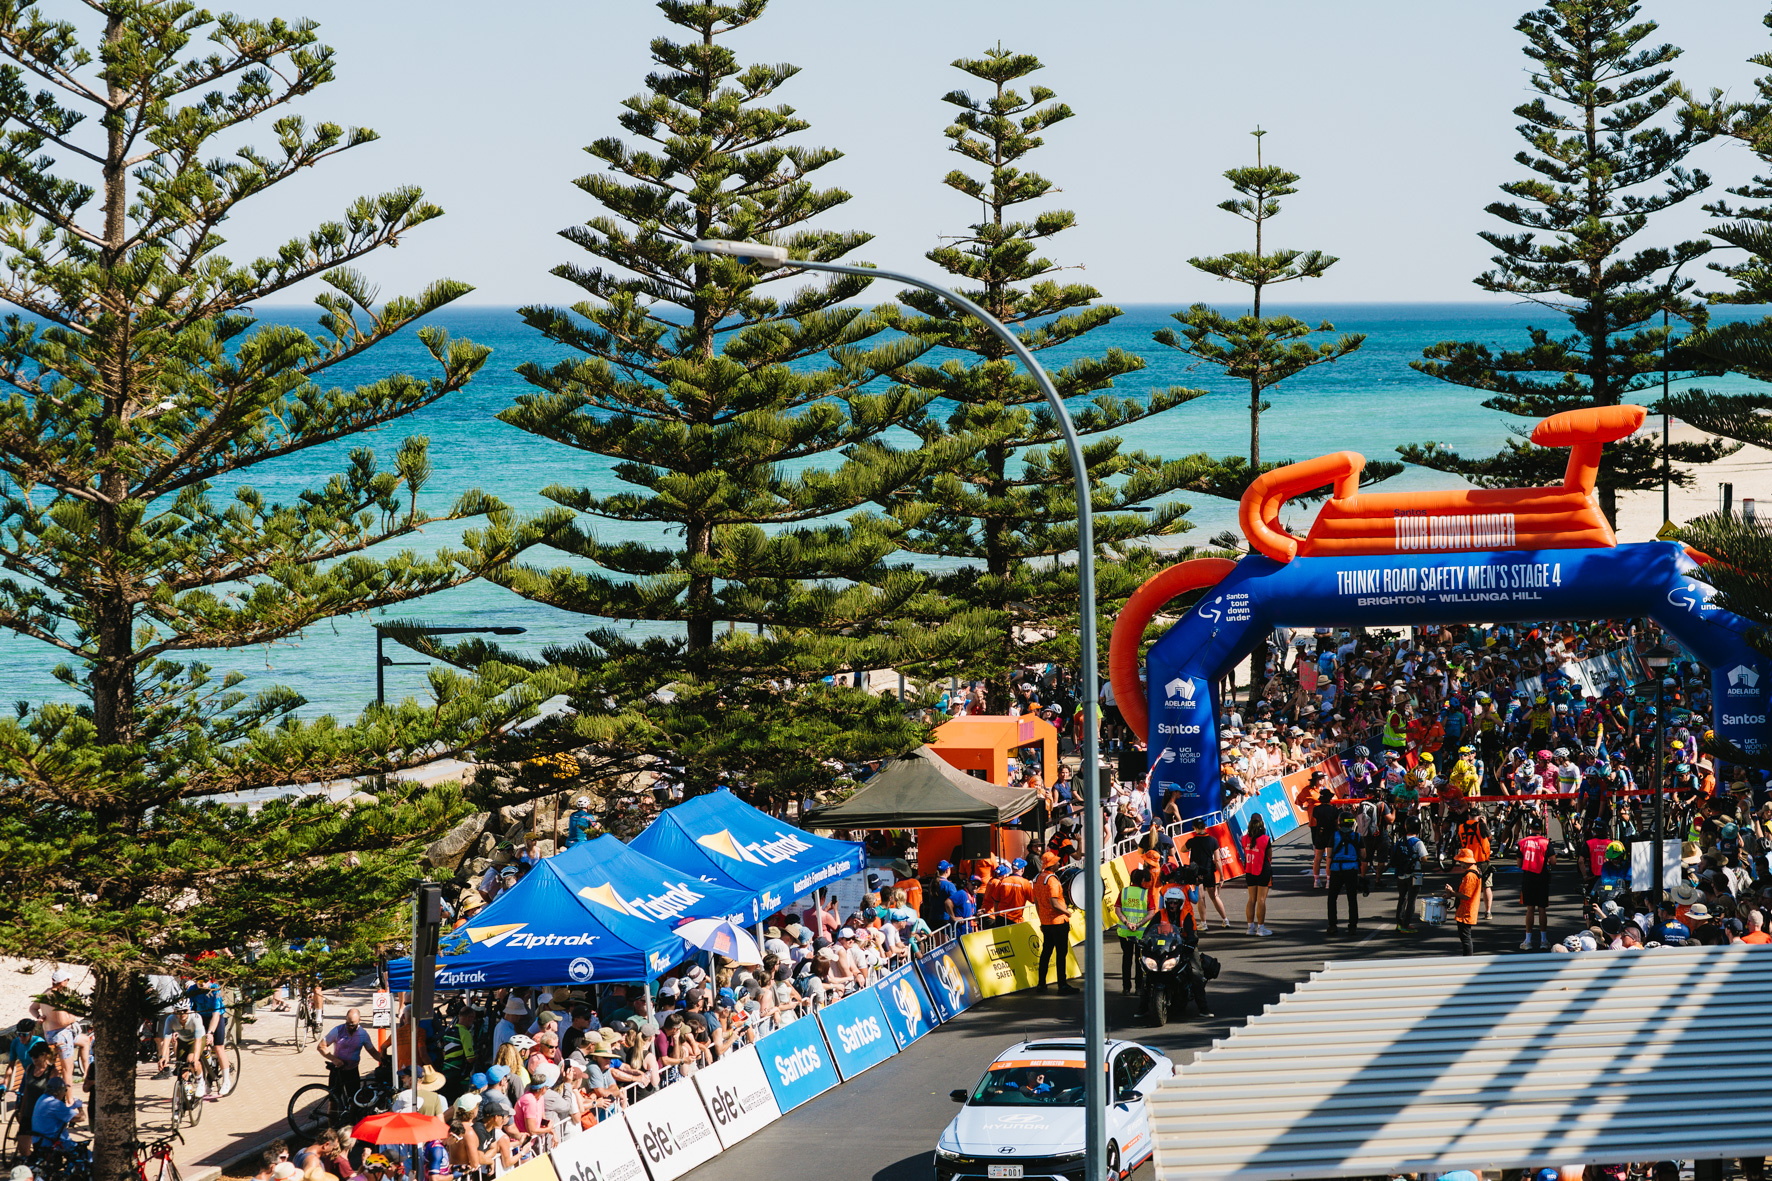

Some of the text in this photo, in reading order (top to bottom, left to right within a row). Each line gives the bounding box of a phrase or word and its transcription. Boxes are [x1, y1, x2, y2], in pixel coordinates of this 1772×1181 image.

[1394, 513, 1516, 550] TOUR DOWN UNDER
[1337, 562, 1562, 595] THINK! ROAD SAFETY MEN'S STAGE 4
[1357, 595, 1426, 606] BRIGHTON
[1439, 592, 1510, 603] WILLUNGA
[1512, 591, 1542, 600] HILL
[1226, 614, 1251, 622] under
[1722, 714, 1766, 725] Santos
[1158, 723, 1200, 734] Santos
[745, 831, 813, 863] Ziptrak
[629, 881, 705, 920] Ziptrak
[505, 932, 598, 949] Ziptrak
[993, 961, 1010, 971] ROAD
[996, 969, 1016, 980] SAFETY
[440, 970, 486, 986] Ziptrak
[836, 1016, 882, 1054] Santos
[774, 1044, 822, 1087] Santos
[711, 1085, 746, 1126] efex
[643, 1121, 681, 1163] efex
[1008, 1168, 1021, 1177] 001
